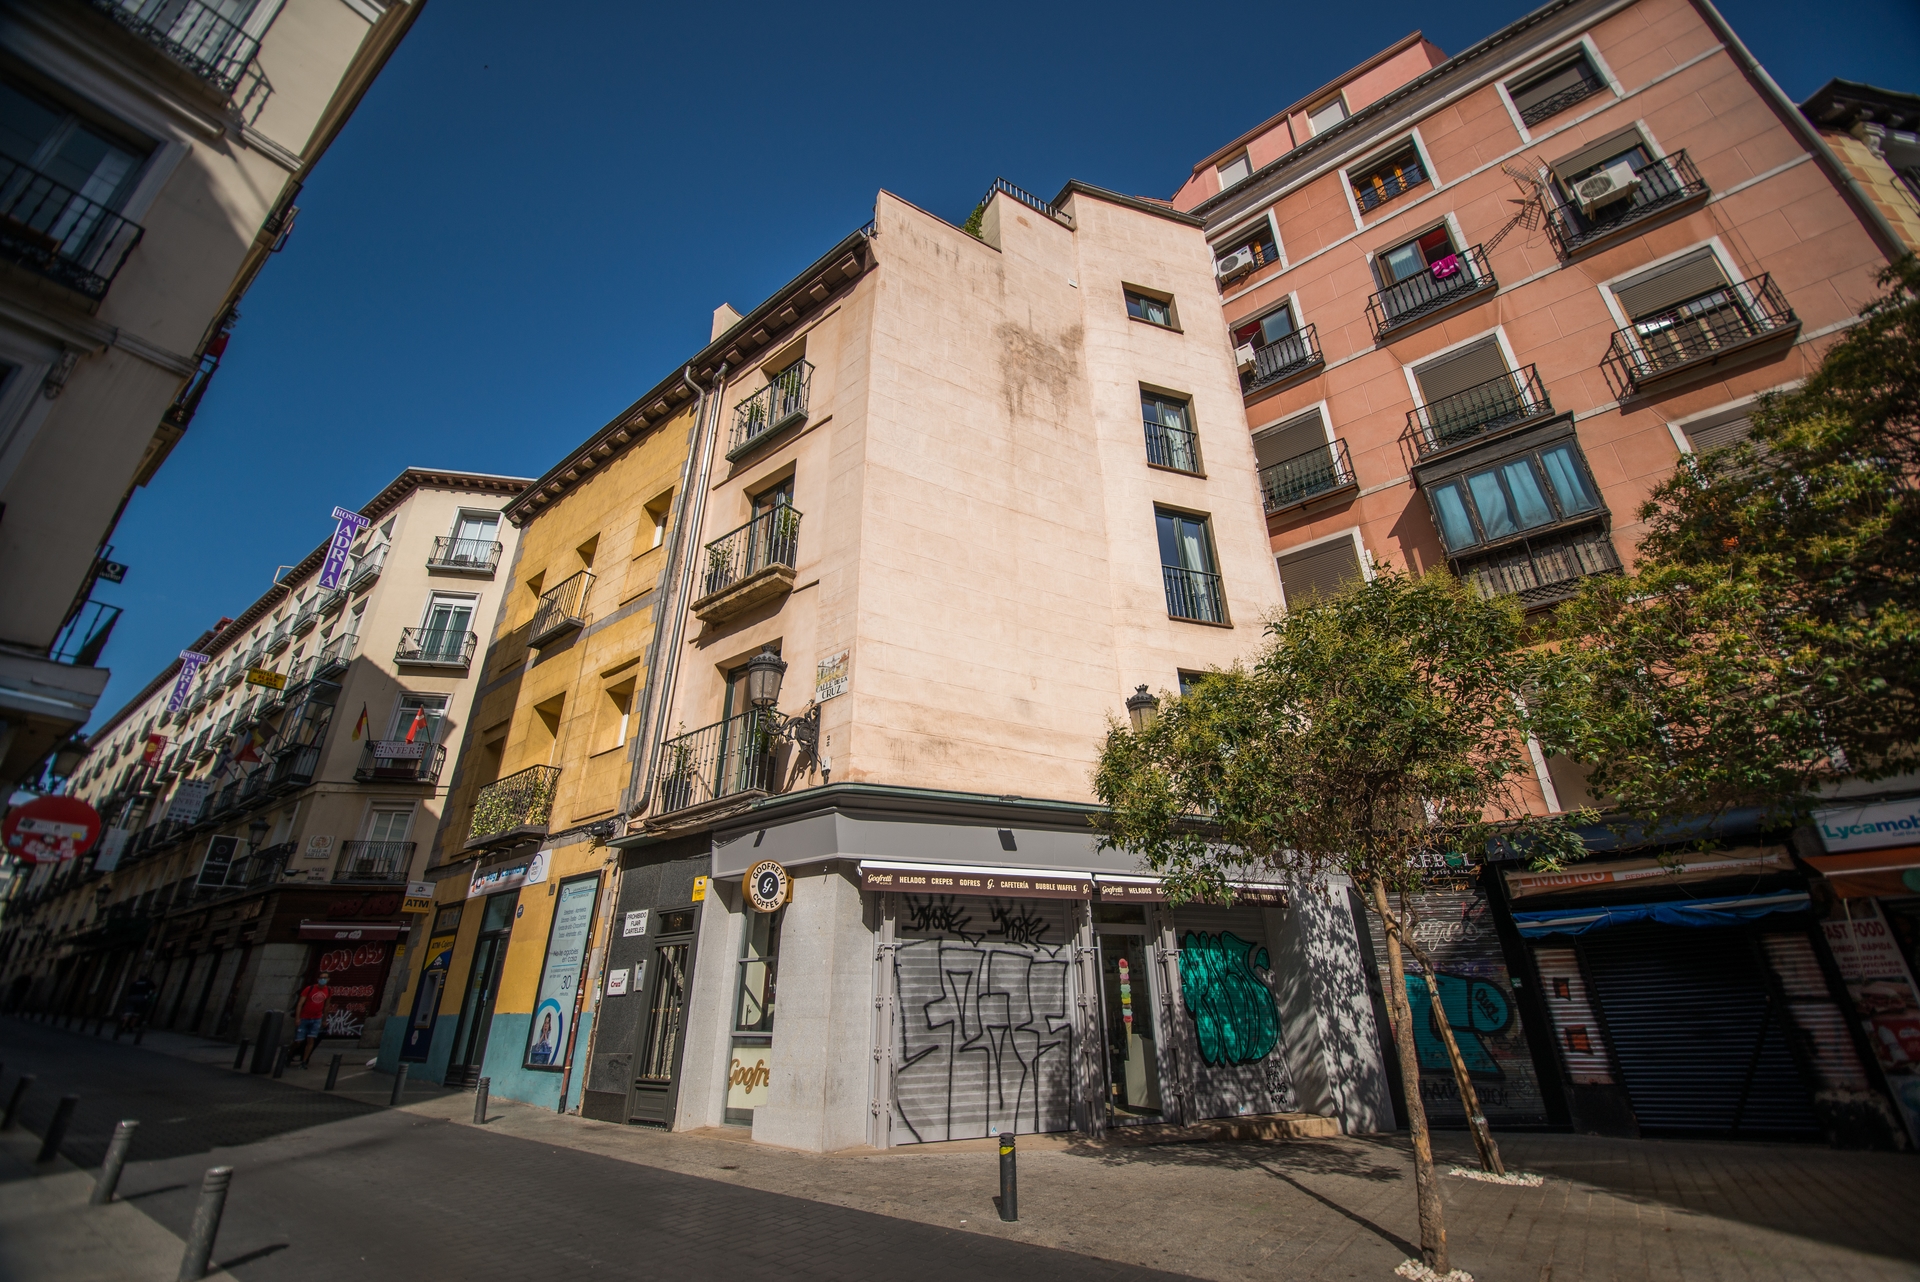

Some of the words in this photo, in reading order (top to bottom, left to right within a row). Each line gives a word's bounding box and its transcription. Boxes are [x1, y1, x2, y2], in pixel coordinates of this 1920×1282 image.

[335, 508, 367, 527] HOSTAL
[321, 525, 352, 588] ADRIA
[182, 651, 207, 662] HOSTAL
[167, 661, 195, 711] ADRIANO
[816, 682, 833, 693] CALLE
[822, 685, 841, 699] CRUZ
[383, 746, 415, 755] INTER
[502, 863, 528, 877] Laundry
[753, 862, 786, 885] GOOFRETTI
[868, 873, 893, 884] Goofretti
[899, 876, 926, 884] HELADOS
[931, 877, 954, 885] CREPES
[959, 878, 981, 887] GOFRES
[1000, 880, 1029, 889] CAFETERÍA
[1035, 882, 1056, 891] BUBBLE
[1056, 883, 1077, 892] WAFFLE
[1101, 885, 1124, 896] Goofretti
[1128, 887, 1153, 895] HELADOS
[404, 898, 430, 908] ATM
[753, 893, 780, 909] COFFEE
[627, 911, 647, 920] PROHIBIDO
[624, 927, 645, 935] CARTELES
[1861, 941, 1893, 951] RÁPIDA
[320, 948, 352, 973] DON
[353, 939, 387, 967] OSO
[560, 974, 572, 990] 30
